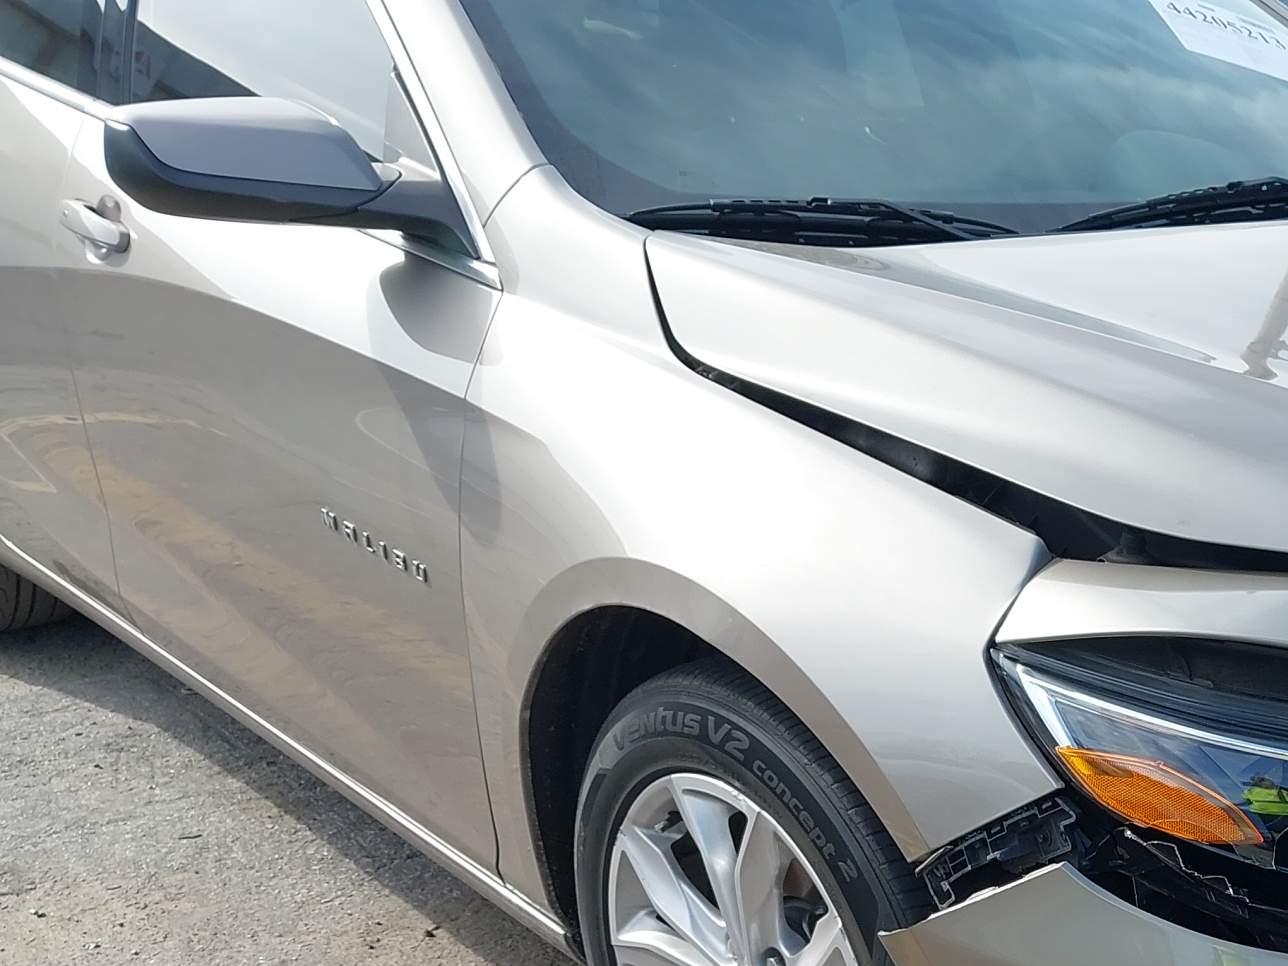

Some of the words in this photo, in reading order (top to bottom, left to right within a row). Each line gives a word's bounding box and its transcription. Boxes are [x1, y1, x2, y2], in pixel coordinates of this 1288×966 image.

[706, 714, 751, 762] V2
[752, 758, 839, 860] concept
[837, 855, 860, 884] 2
